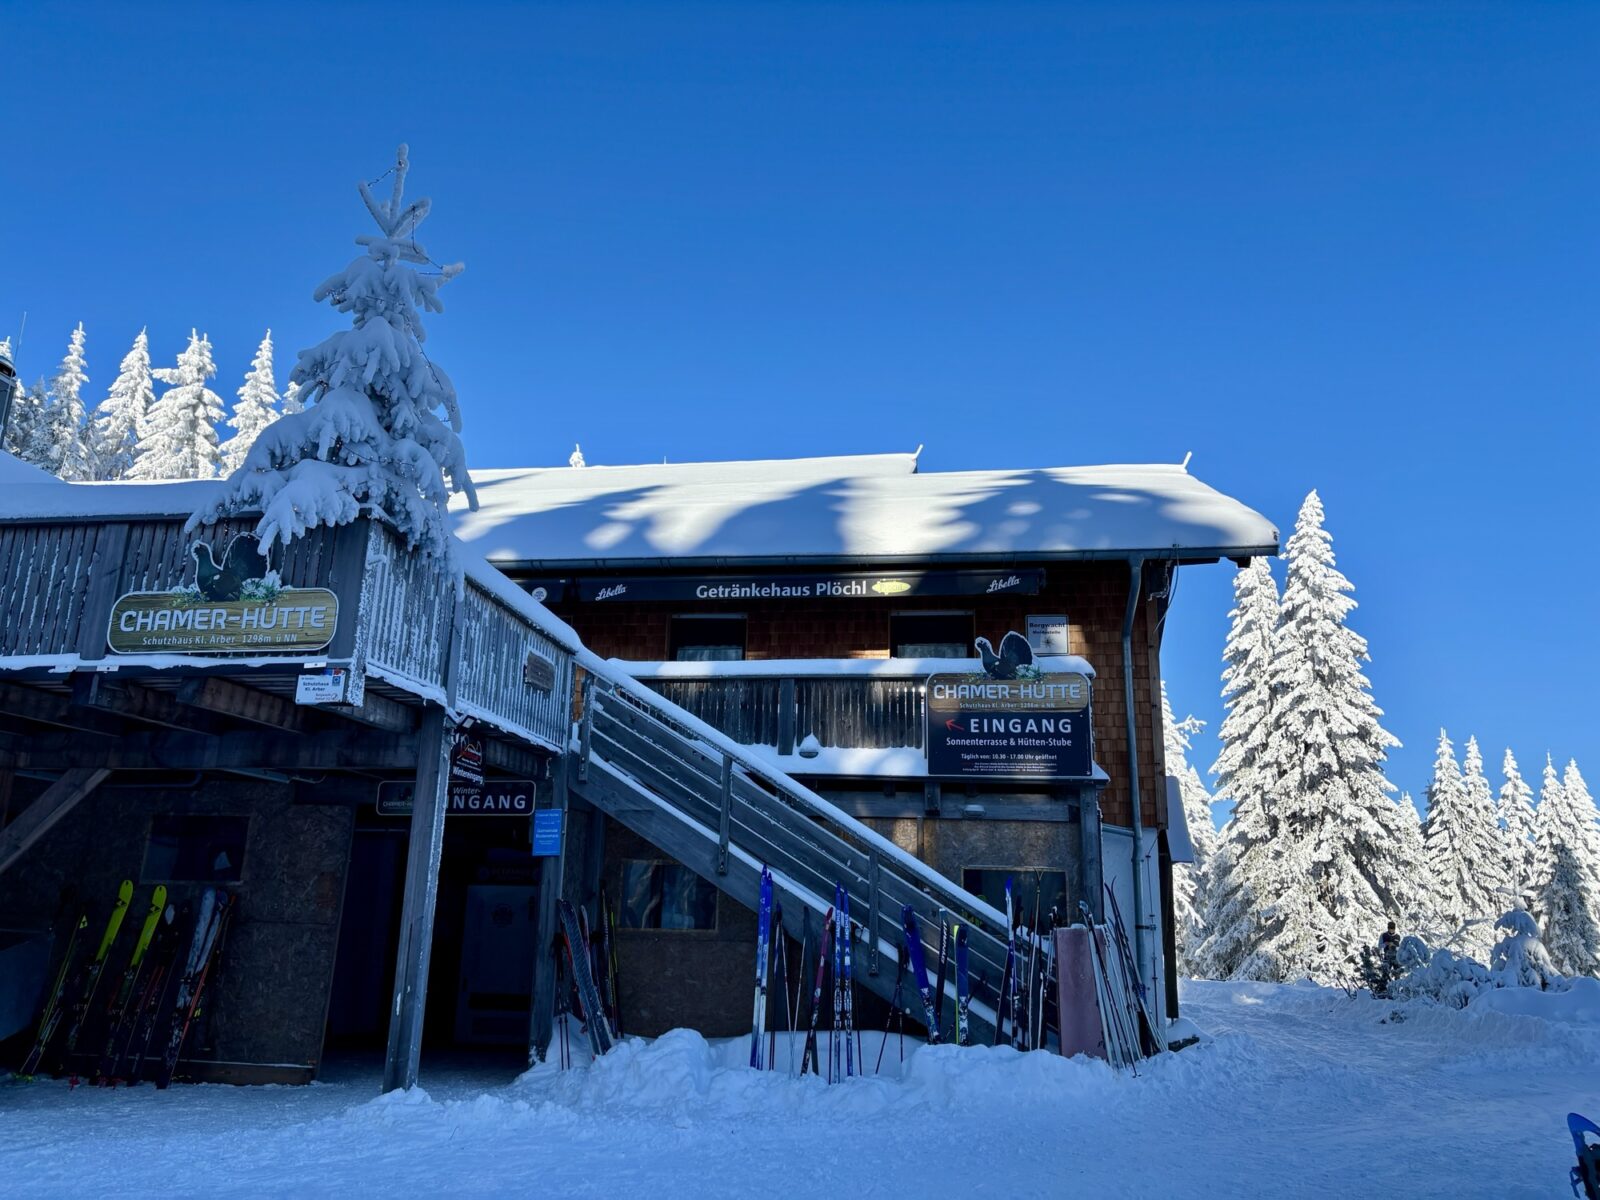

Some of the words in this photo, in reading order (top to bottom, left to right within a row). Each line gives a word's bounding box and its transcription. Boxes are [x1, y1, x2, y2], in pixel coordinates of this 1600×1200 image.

[595, 583, 628, 602] Libella
[695, 581, 811, 599] Getränkehaus
[815, 579, 868, 598] Plöchl
[986, 575, 1022, 595] Libella
[120, 602, 327, 632] CHAMER-HÜTTE
[142, 635, 194, 646] Schutzhaus
[194, 635, 208, 645] Kl.
[209, 634, 236, 645] Arber
[242, 634, 272, 643] 1298m
[283, 633, 298, 643] NN
[934, 681, 1081, 700] CHAMER-HÜTTE
[969, 718, 1073, 734] EINGANG
[946, 737, 1008, 747] Sonnenterrasse
[1009, 737, 1016, 746] &
[1017, 736, 1073, 747] Hütten-Stube
[961, 753, 978, 761] Täglich
[453, 786, 482, 795] Winter-
